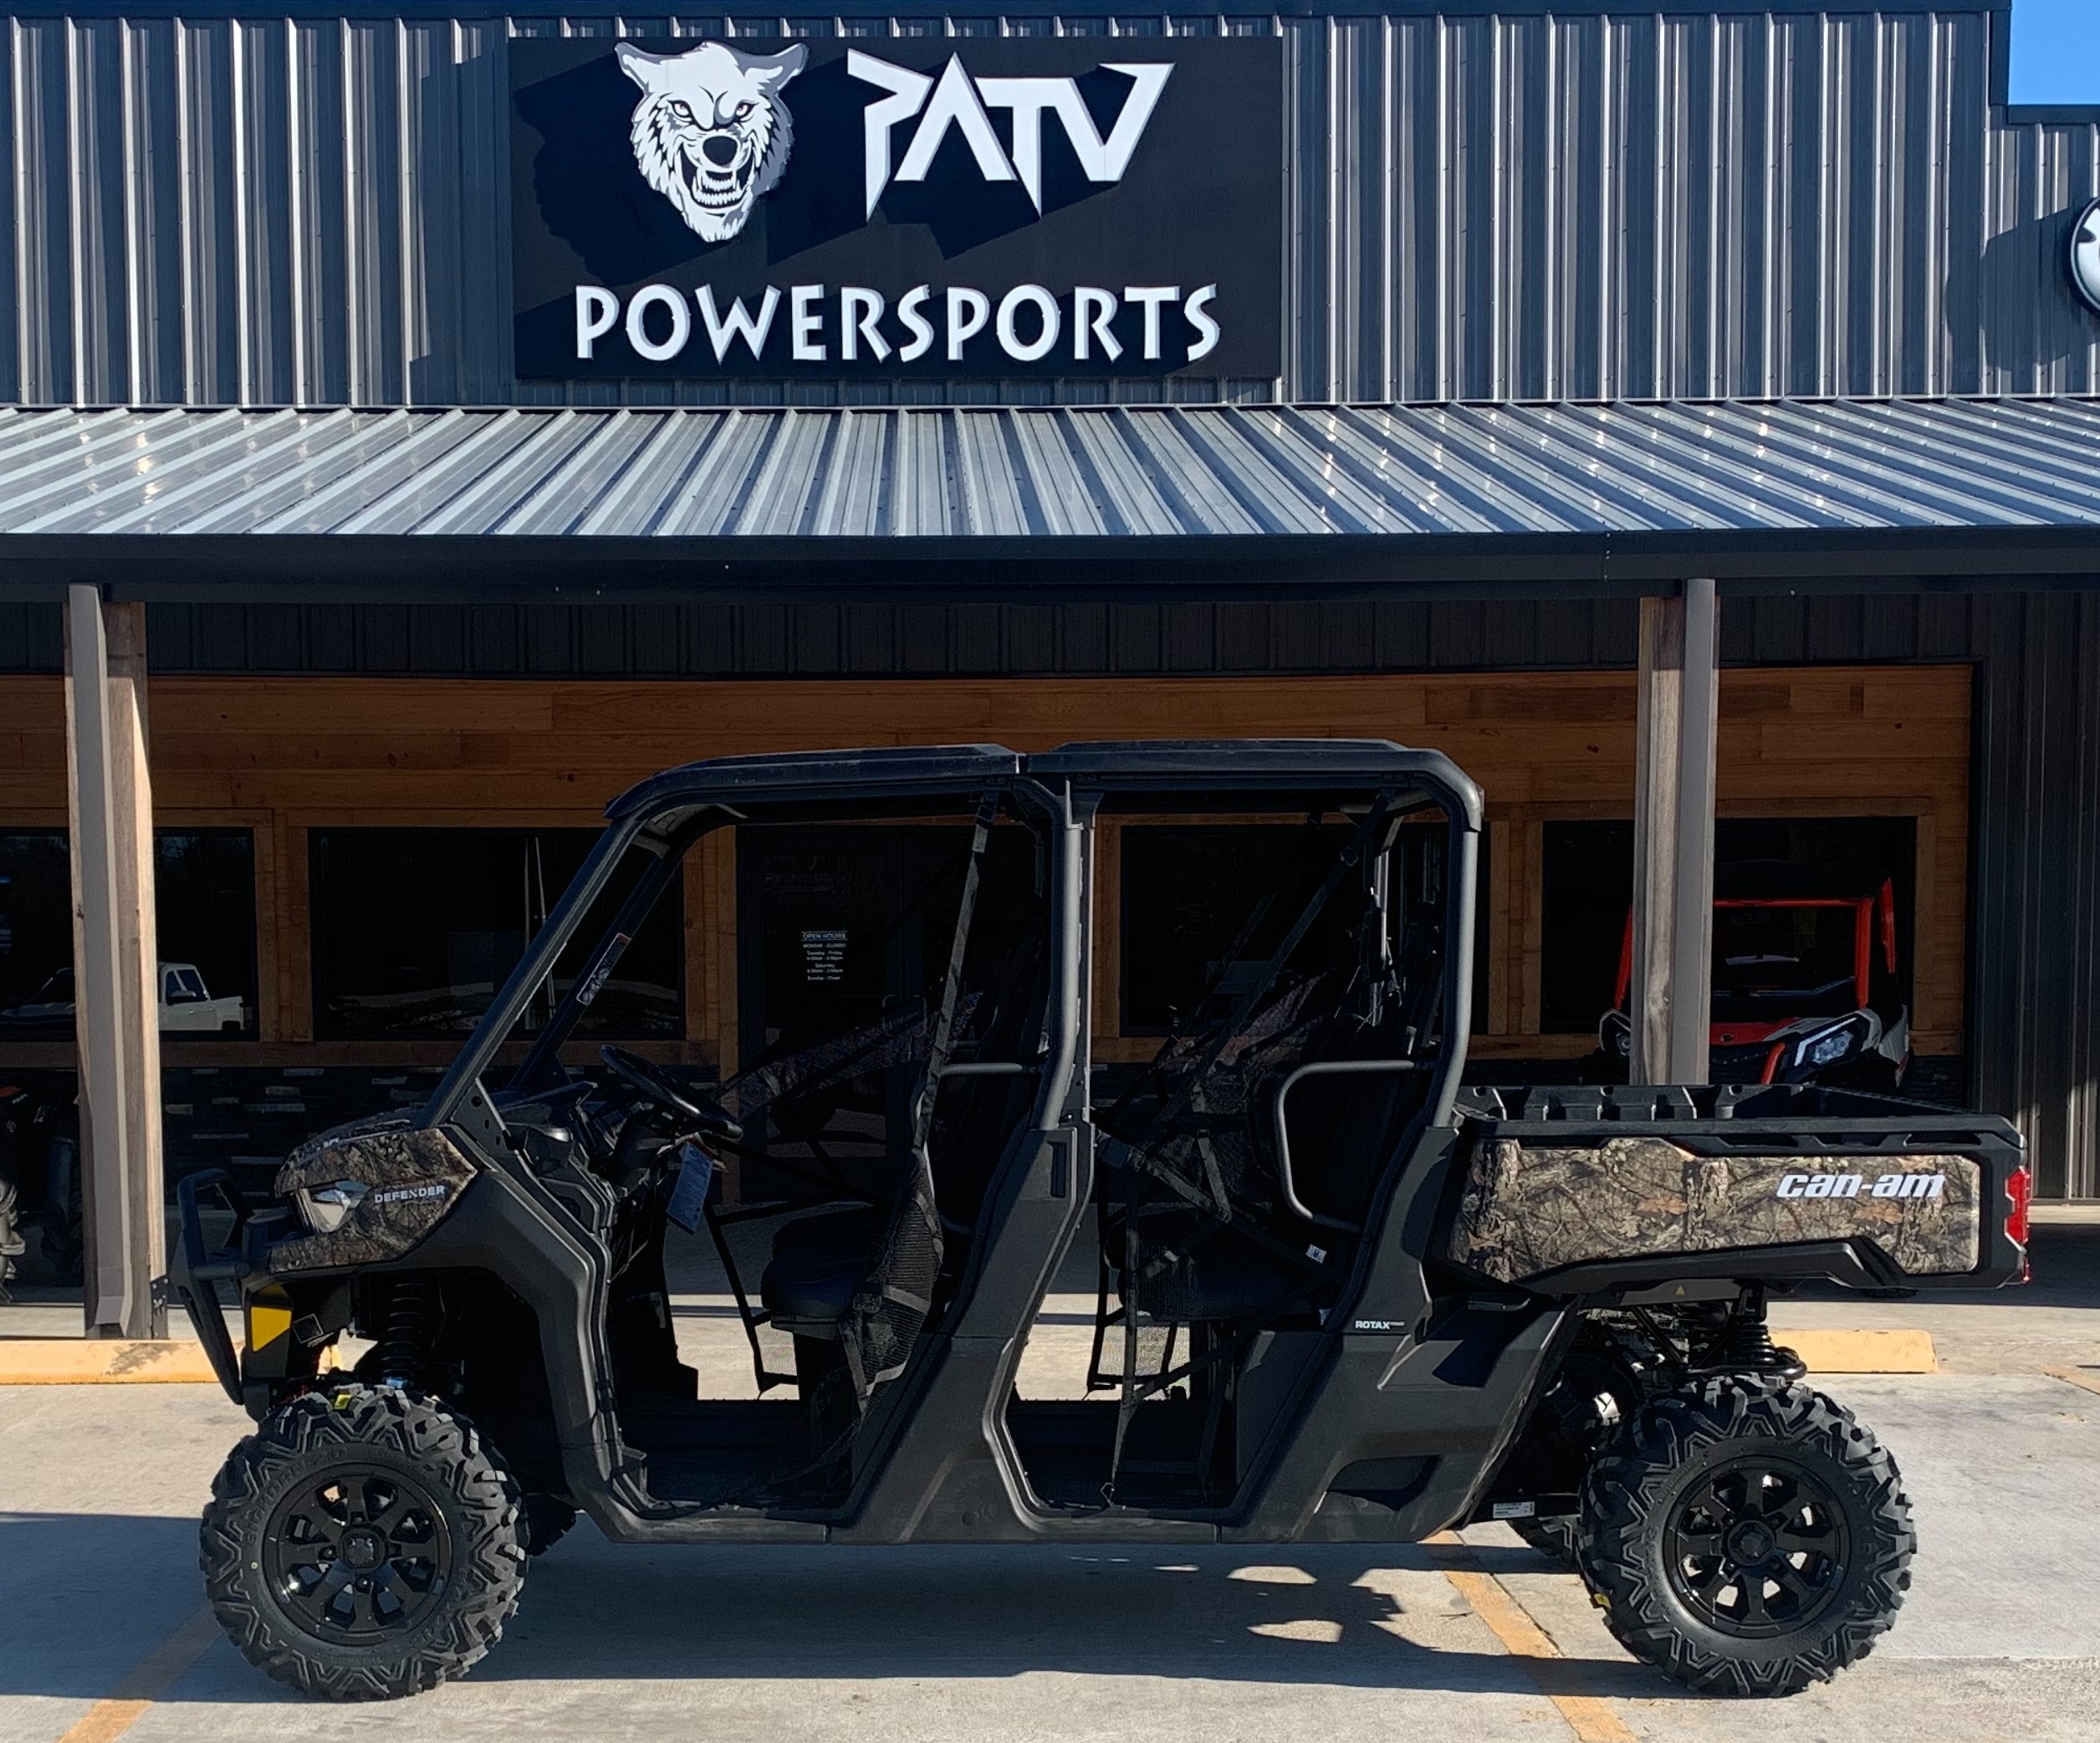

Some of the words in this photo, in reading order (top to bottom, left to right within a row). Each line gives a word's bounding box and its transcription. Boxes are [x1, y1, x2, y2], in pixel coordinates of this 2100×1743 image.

[847, 48, 1176, 222] PATV
[575, 282, 1221, 364] POWERSPORTS
[374, 1185, 446, 1204] DEFENDER
[1776, 1174, 1946, 1198] can-am
[1355, 1320, 1391, 1330] ROTAX
